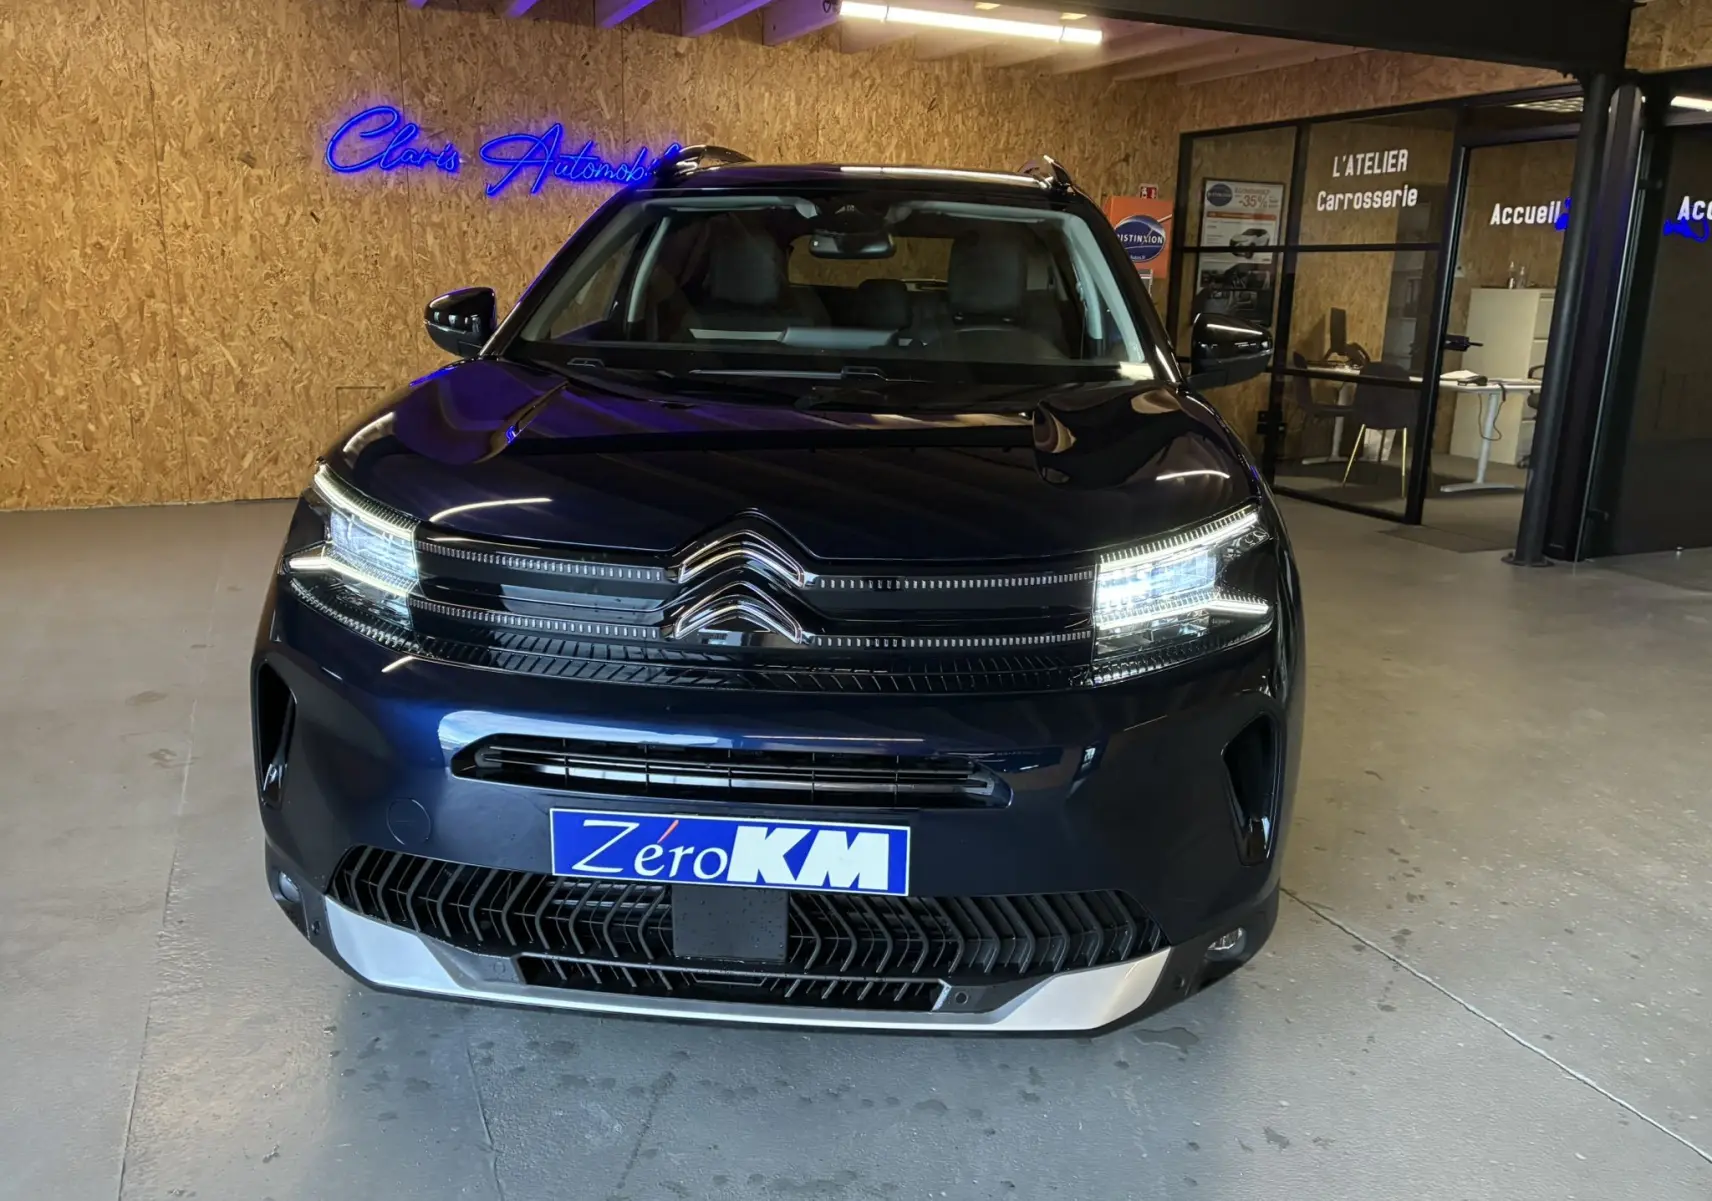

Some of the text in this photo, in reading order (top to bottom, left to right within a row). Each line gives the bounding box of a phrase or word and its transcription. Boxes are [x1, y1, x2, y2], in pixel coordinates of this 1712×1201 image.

[325, 105, 459, 173] Claris
[1332, 148, 1409, 178] L'ATELIER
[1316, 184, 1418, 212] Carrosserie
[1490, 200, 1562, 226] Accueil
